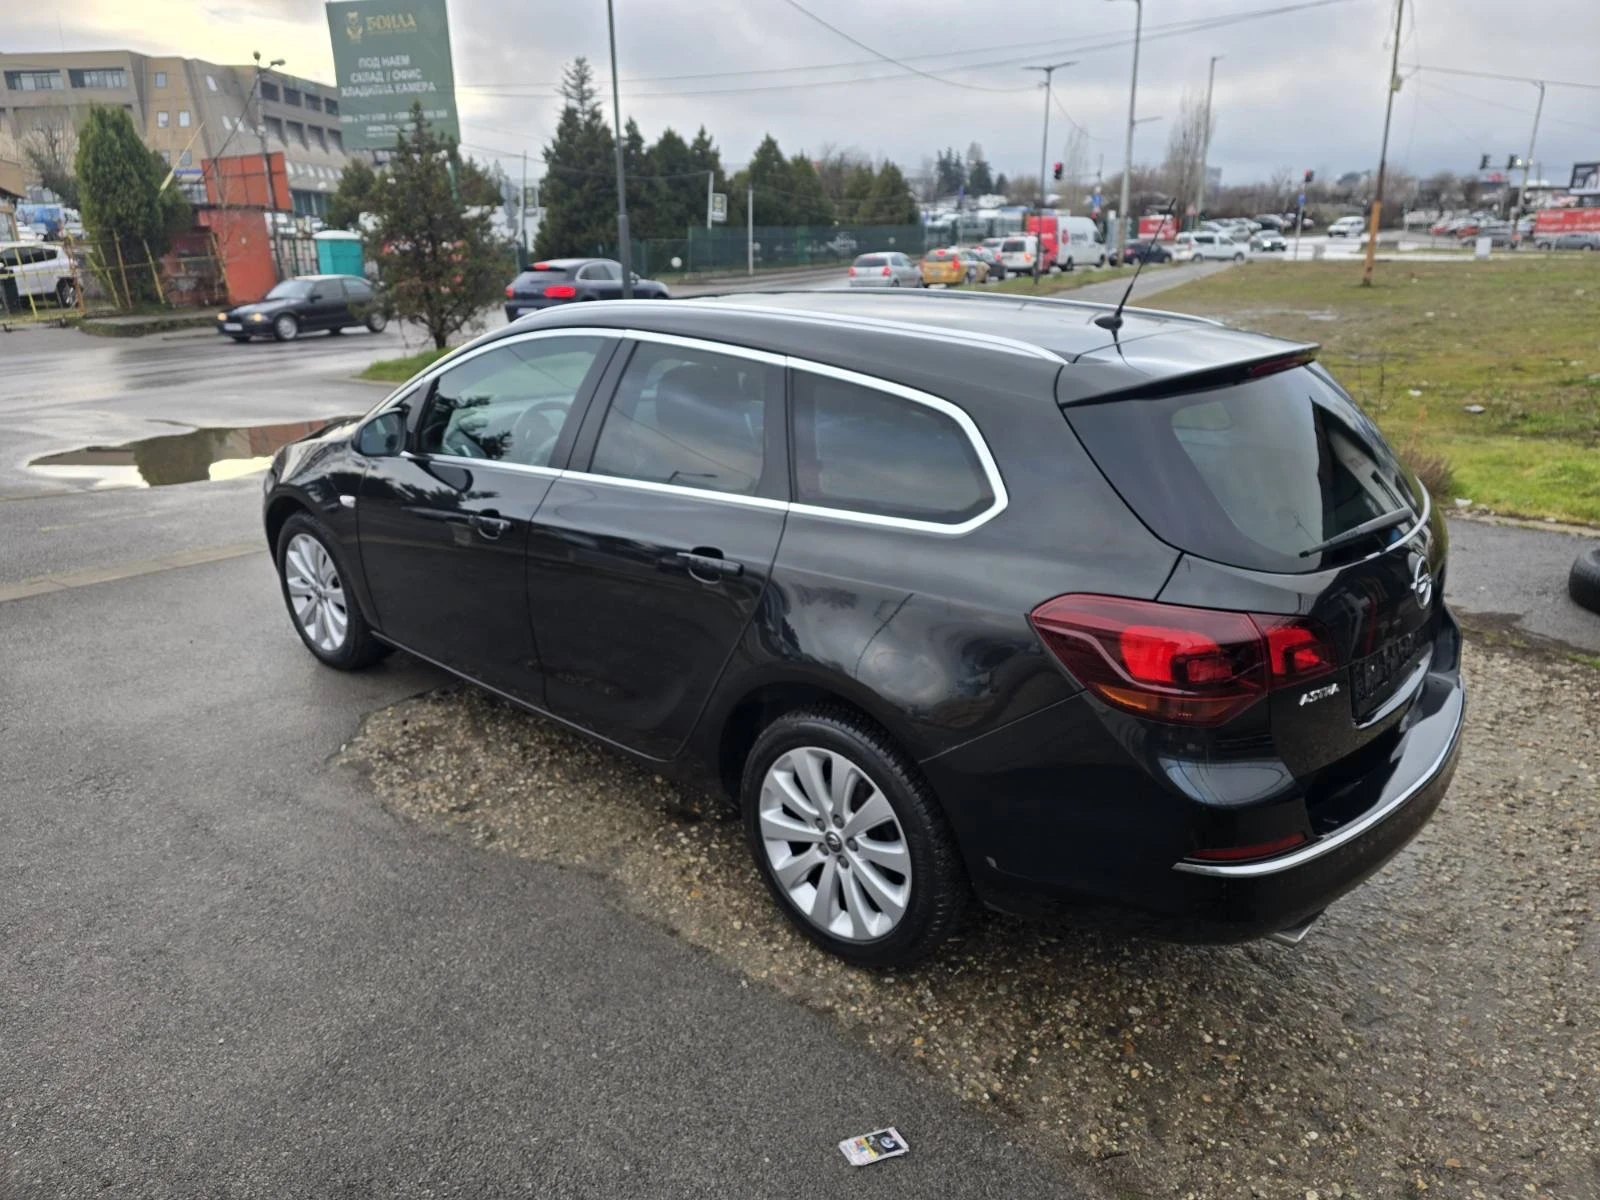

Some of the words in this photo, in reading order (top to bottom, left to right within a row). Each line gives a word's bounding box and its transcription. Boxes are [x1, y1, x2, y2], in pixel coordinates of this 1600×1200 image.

[358, 56, 380, 69] ПОД
[382, 55, 410, 67] НАЕМ
[351, 72, 384, 84] СКЛАД
[391, 68, 422, 81] ОФИС
[395, 82, 436, 93] КАМЕРА
[1299, 683, 1340, 706] ASTRA
